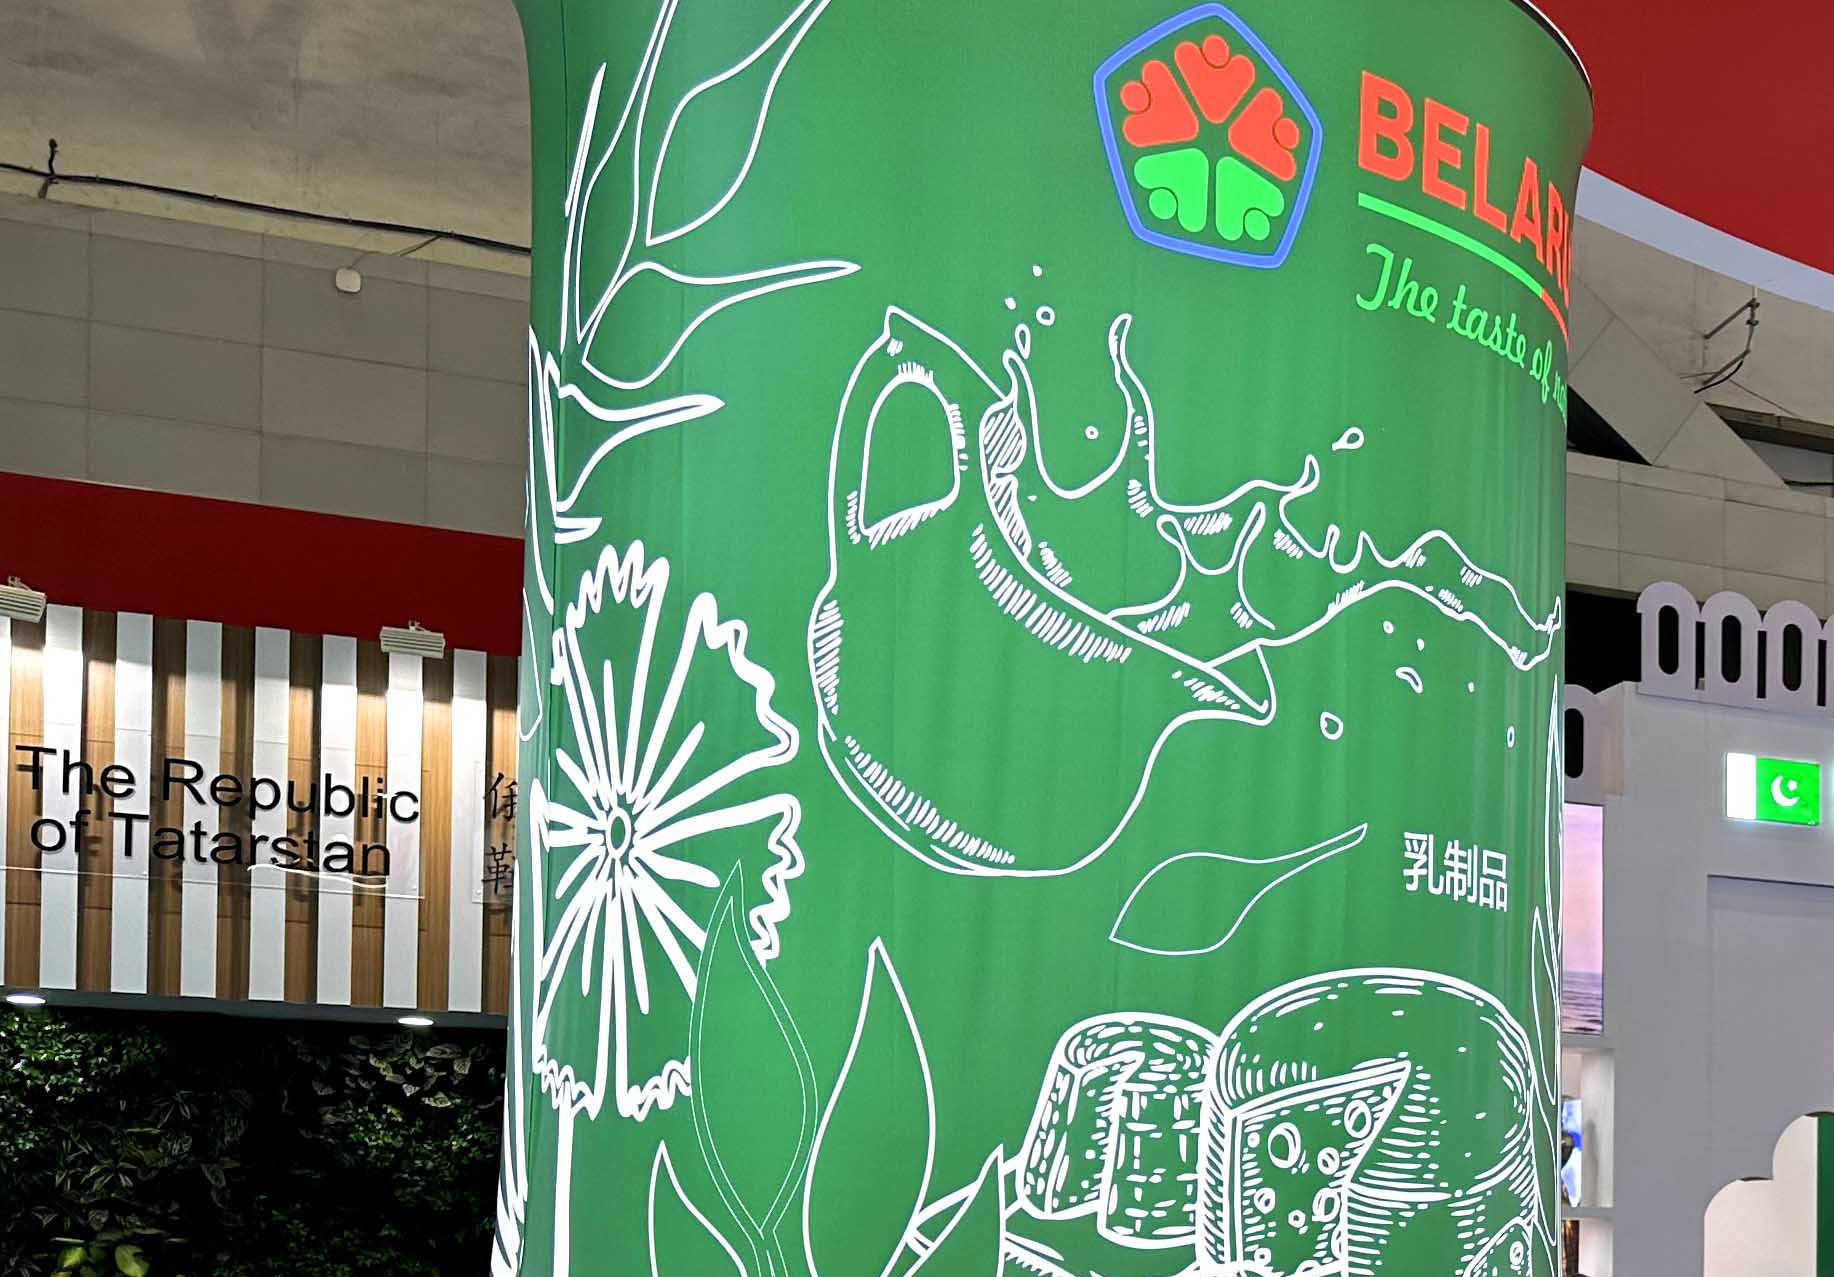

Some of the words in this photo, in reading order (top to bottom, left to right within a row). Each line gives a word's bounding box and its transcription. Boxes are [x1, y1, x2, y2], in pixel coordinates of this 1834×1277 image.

[1356, 243, 1437, 325] The
[1447, 284, 1525, 369] taste
[1530, 340, 1553, 405] of
[16, 745, 136, 799] The
[162, 757, 420, 824] Republic
[31, 810, 91, 854] of
[108, 812, 391, 877] Tatarstan
[1403, 831, 1508, 912] 乳制品
